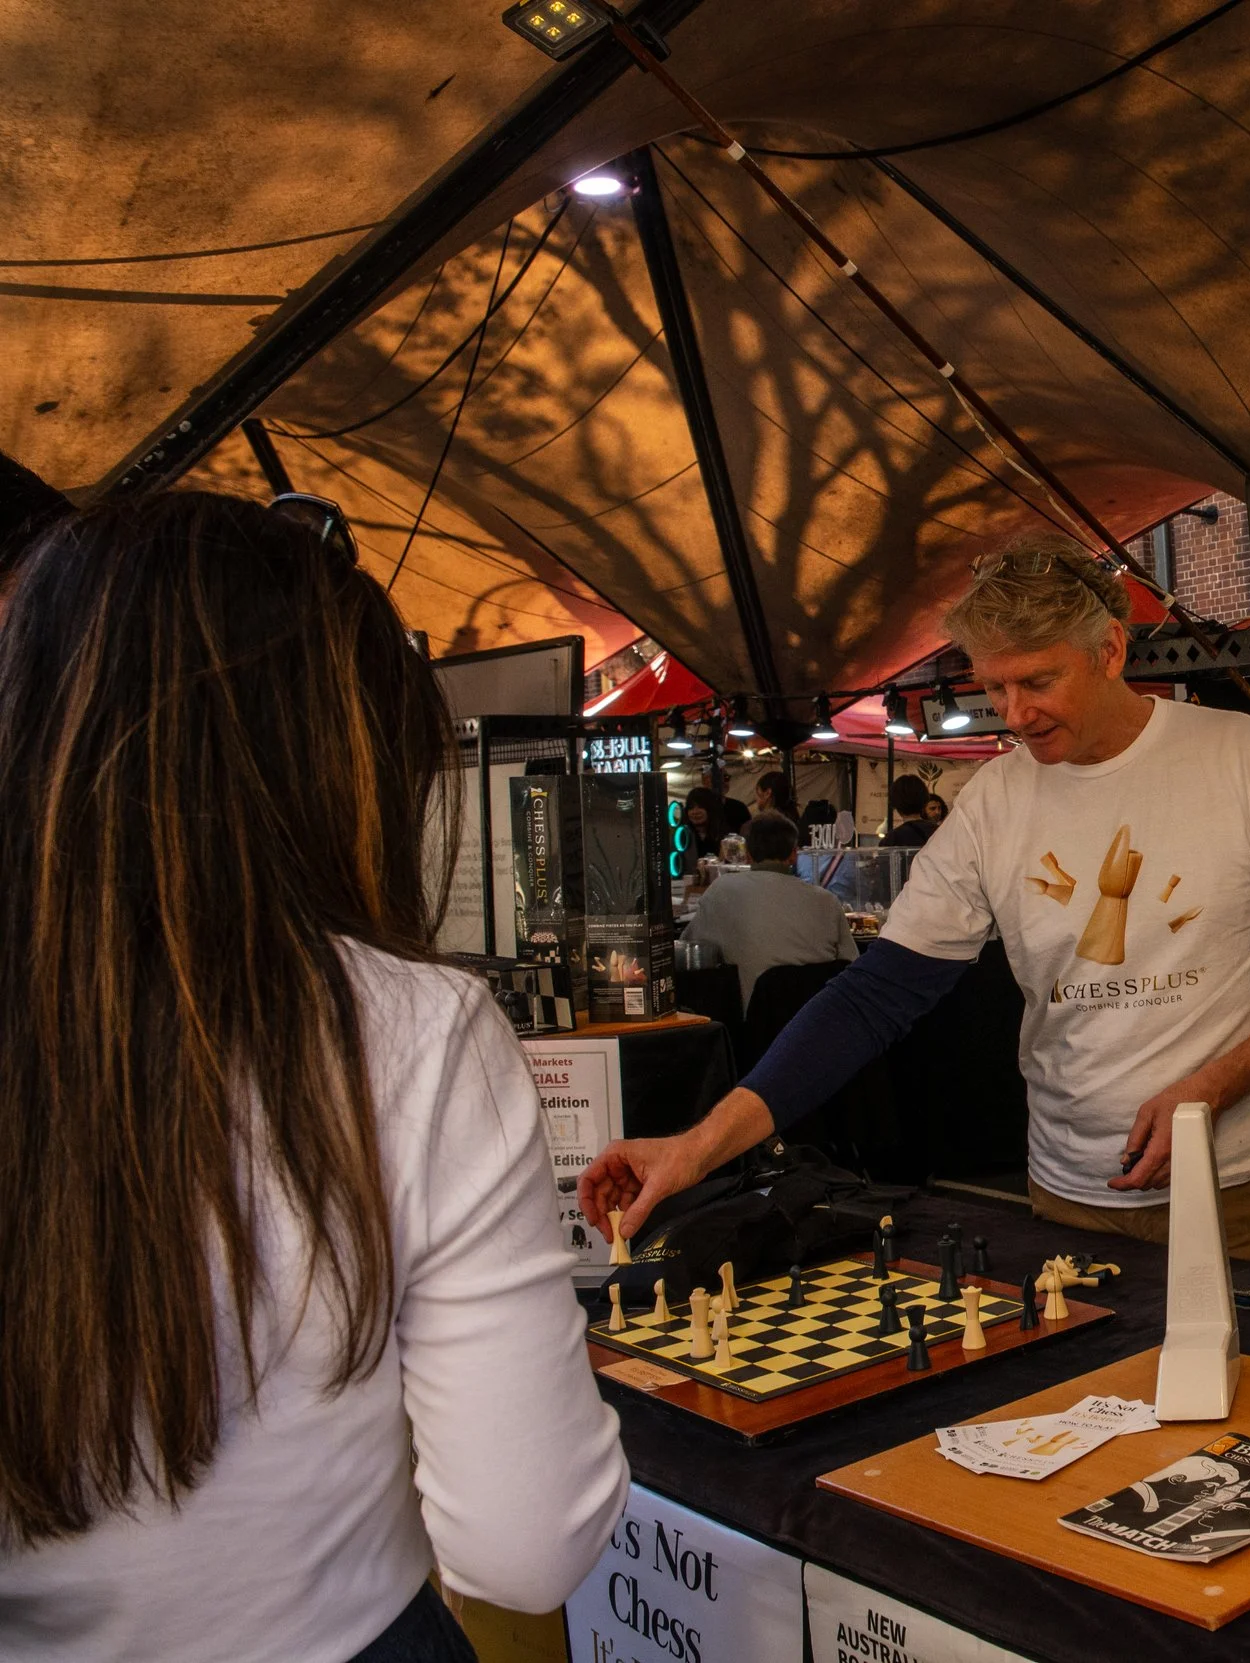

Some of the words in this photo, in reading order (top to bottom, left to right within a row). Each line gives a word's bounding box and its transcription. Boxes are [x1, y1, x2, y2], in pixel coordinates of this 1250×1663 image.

[533, 798, 548, 899] CHESSPLUS
[1075, 1001, 1120, 1012] COMBINE
[1133, 994, 1183, 1009] CONQUER
[533, 1057, 573, 1067] Markets
[540, 1096, 590, 1109] Edition
[554, 1154, 593, 1167] Editio
[1088, 1407, 1124, 1417] Chess
[1091, 1400, 1110, 1408] It's
[1113, 1404, 1138, 1412] Not
[1058, 1419, 1078, 1427] HOW
[1093, 1423, 1117, 1431] PLAY
[1102, 1522, 1178, 1551] MATCH
[653, 1520, 719, 1602] Not
[867, 1609, 907, 1648] NEW
